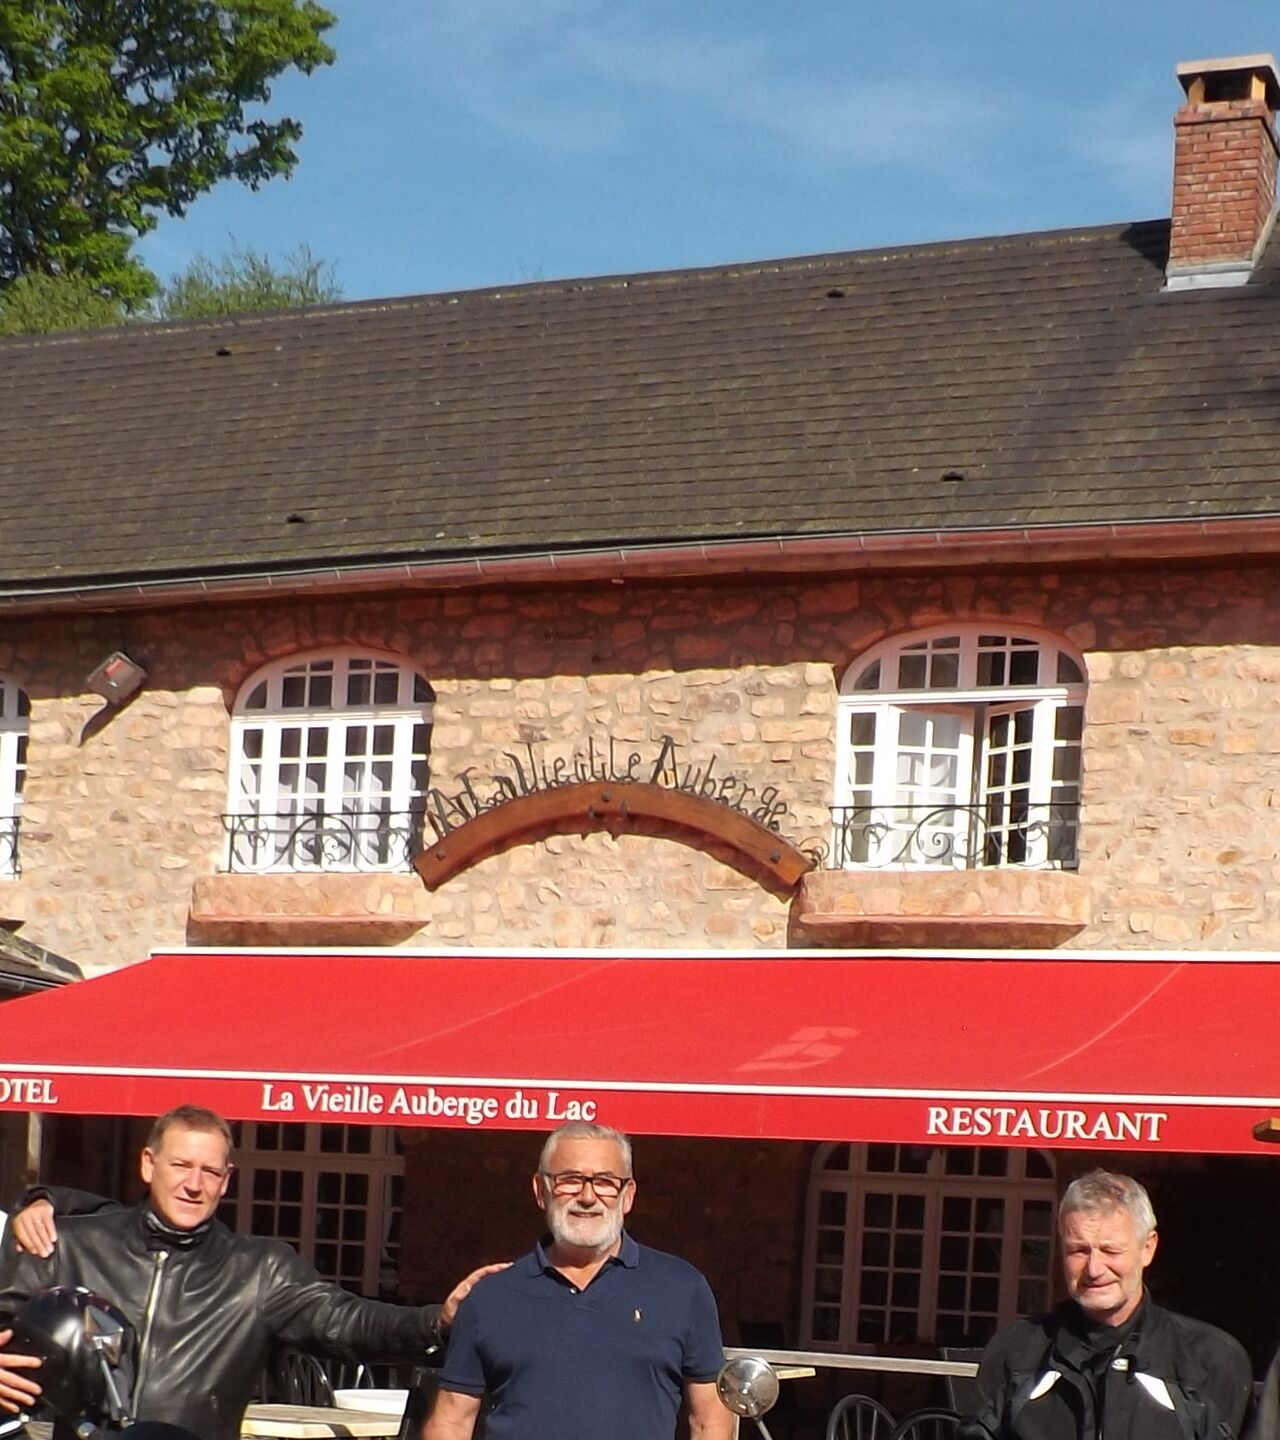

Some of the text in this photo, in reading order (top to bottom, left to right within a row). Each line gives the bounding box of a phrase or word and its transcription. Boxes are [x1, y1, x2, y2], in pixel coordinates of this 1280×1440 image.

[650, 735, 788, 833] Auberge
[261, 1083, 597, 1125] La Vieille Auberge du Lac
[926, 1106, 1168, 1142] RESTAURANT
